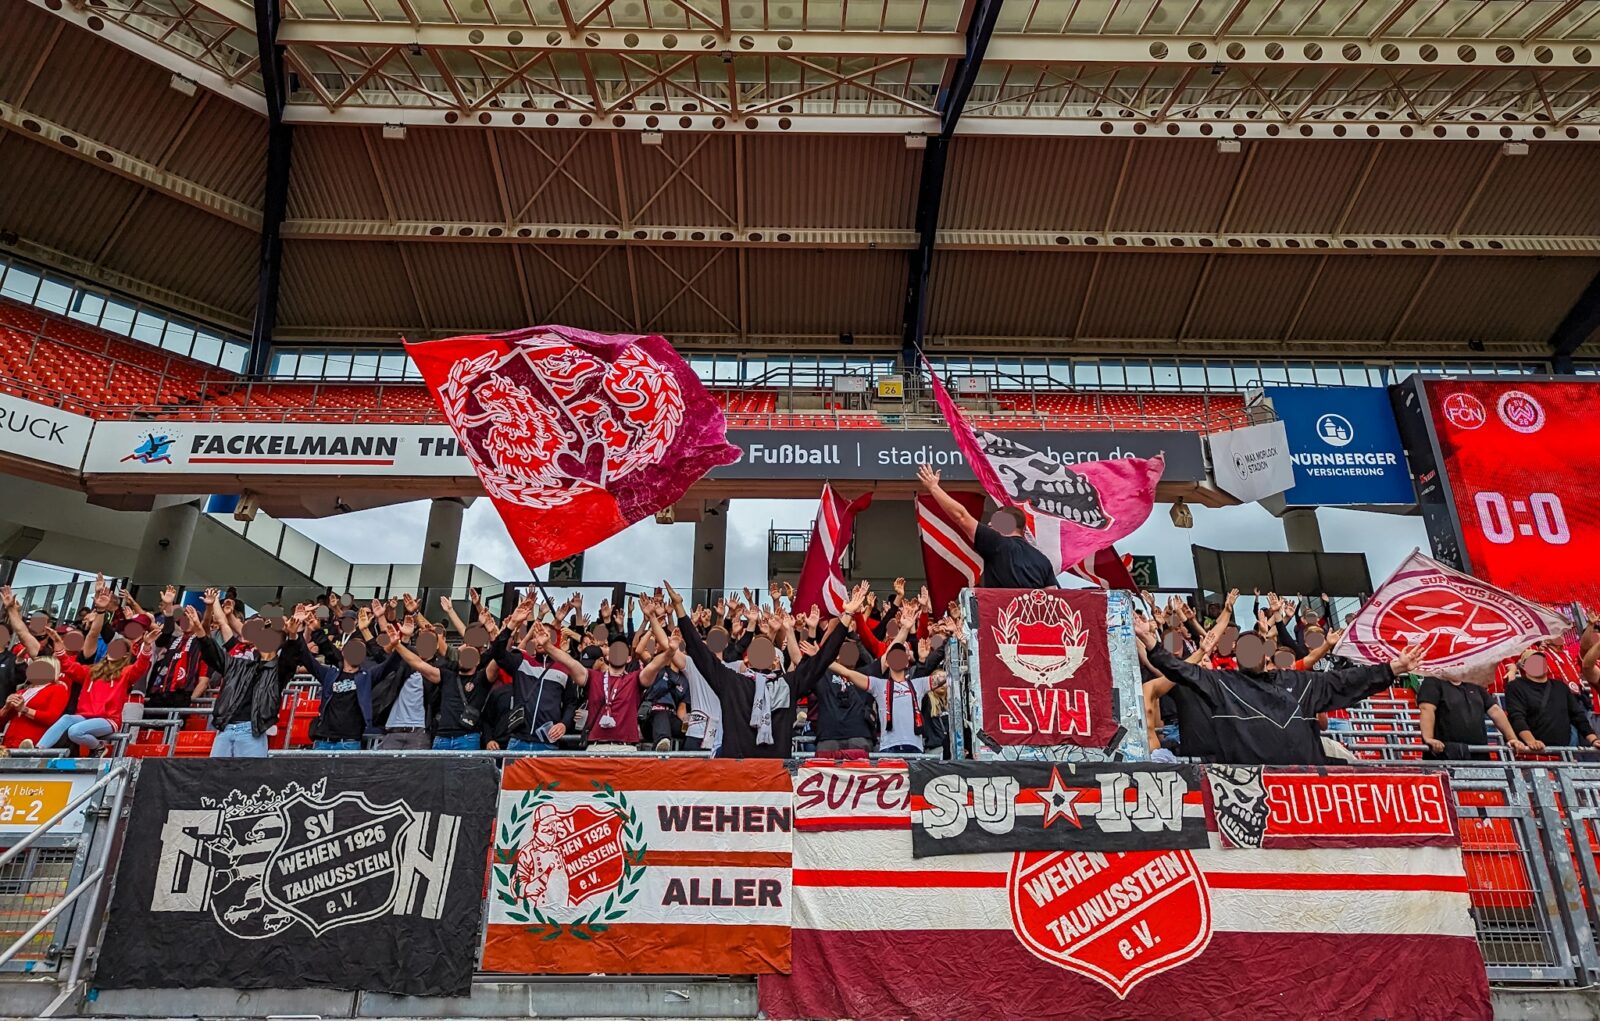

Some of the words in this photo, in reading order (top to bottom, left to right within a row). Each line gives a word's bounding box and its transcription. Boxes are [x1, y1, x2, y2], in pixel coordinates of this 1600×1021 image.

[1449, 407, 1483, 421] FCN
[190, 434, 398, 457] FACKELMANN
[749, 444, 841, 464] Fußball
[1290, 452, 1397, 466] NÜRNBERGER
[1306, 467, 1384, 477] VERSICHERUNG
[1474, 491, 1571, 545] 0:0
[998, 687, 1092, 737] SVW
[657, 804, 791, 833] WEHEN
[922, 773, 1020, 840] SU
[1094, 771, 1189, 833] IN
[1268, 783, 1444, 825] SUPREMUS
[304, 810, 336, 841] SV
[557, 815, 576, 839] SV
[560, 836, 584, 857] HEN
[583, 823, 612, 845] 1926
[277, 842, 341, 876] WEHEN
[344, 825, 386, 854] 1926
[566, 841, 618, 875] NUSSTEIN
[282, 851, 392, 902] TAUNUSSTEIN
[579, 871, 602, 890] e.V.
[661, 877, 783, 908] ALLER
[1022, 850, 1111, 908] WEHEN
[326, 891, 358, 914] e.V.
[1045, 850, 1187, 947] TAUNUSSTEIN
[1117, 919, 1162, 961] e.V.
